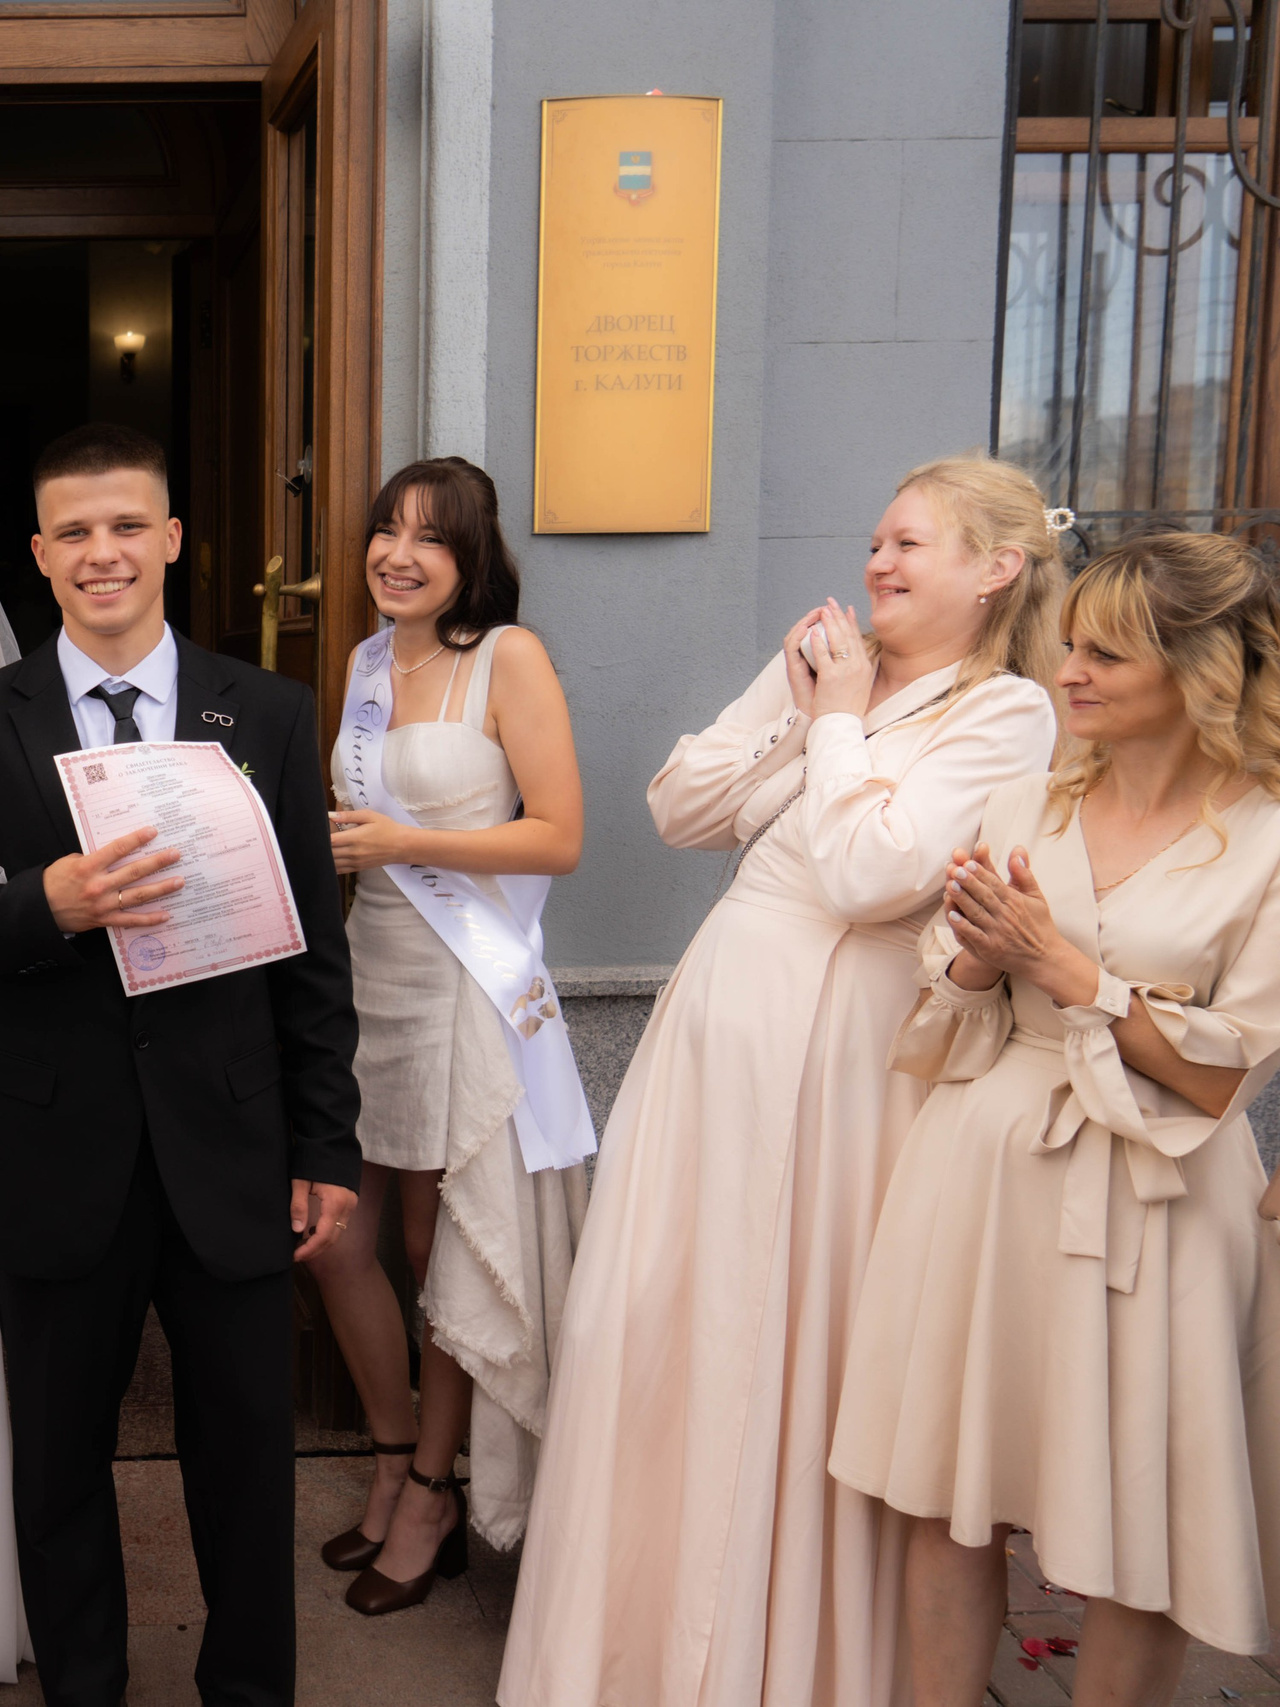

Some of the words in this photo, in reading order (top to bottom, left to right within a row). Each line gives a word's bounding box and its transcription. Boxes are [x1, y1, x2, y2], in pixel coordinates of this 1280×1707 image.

[585, 314, 676, 335] ДВОРЕЦ
[570, 344, 687, 363] ТОРЖЕСТВ
[574, 379, 587, 392] г.
[594, 373, 683, 391] КАЛУГИ
